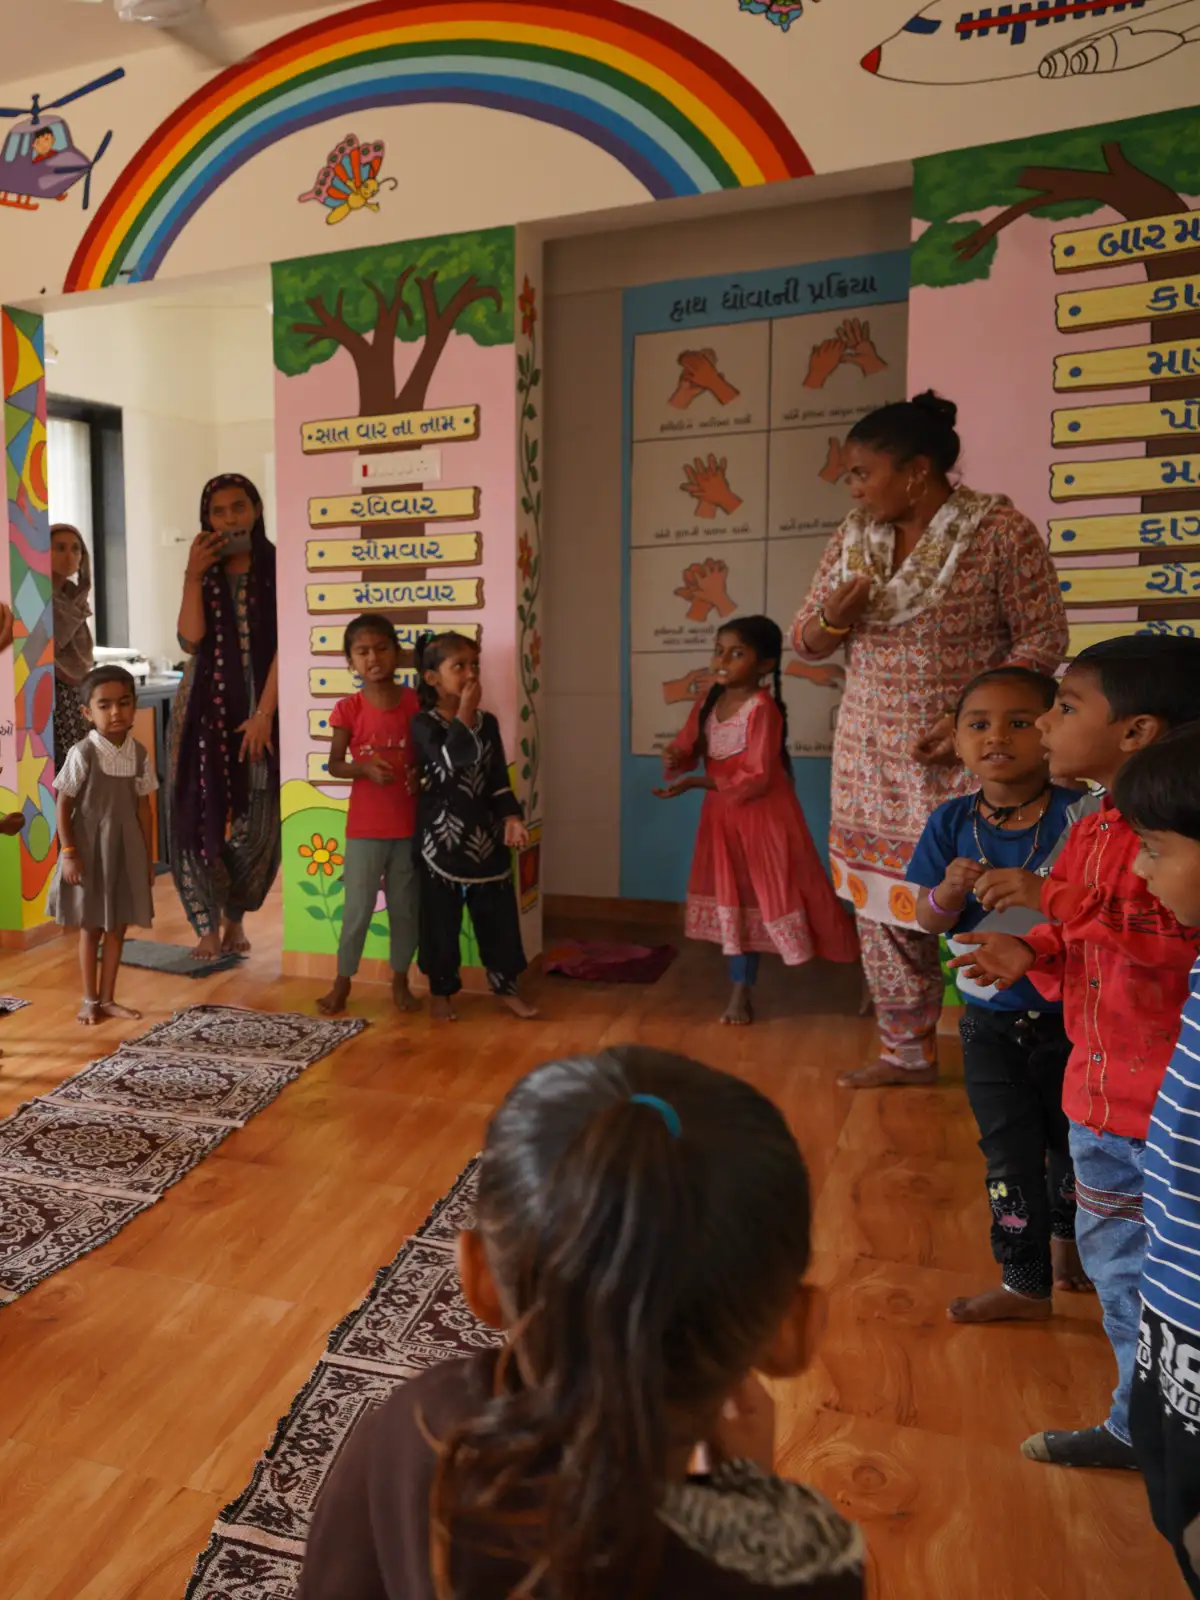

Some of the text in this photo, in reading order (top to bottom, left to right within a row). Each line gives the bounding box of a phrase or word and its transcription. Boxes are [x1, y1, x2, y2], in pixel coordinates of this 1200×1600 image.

[1098, 223, 1166, 257] બાર
[1146, 283, 1200, 311] કા
[315, 415, 456, 445] સાત વાર ના નામ
[350, 495, 438, 518] રવિવાર
[352, 539, 444, 561] સોમવાર
[353, 584, 456, 605] મંગળવાર
[1161, 1371, 1200, 1417] OKYO
[294, 1468, 324, 1506] SHAGUN
